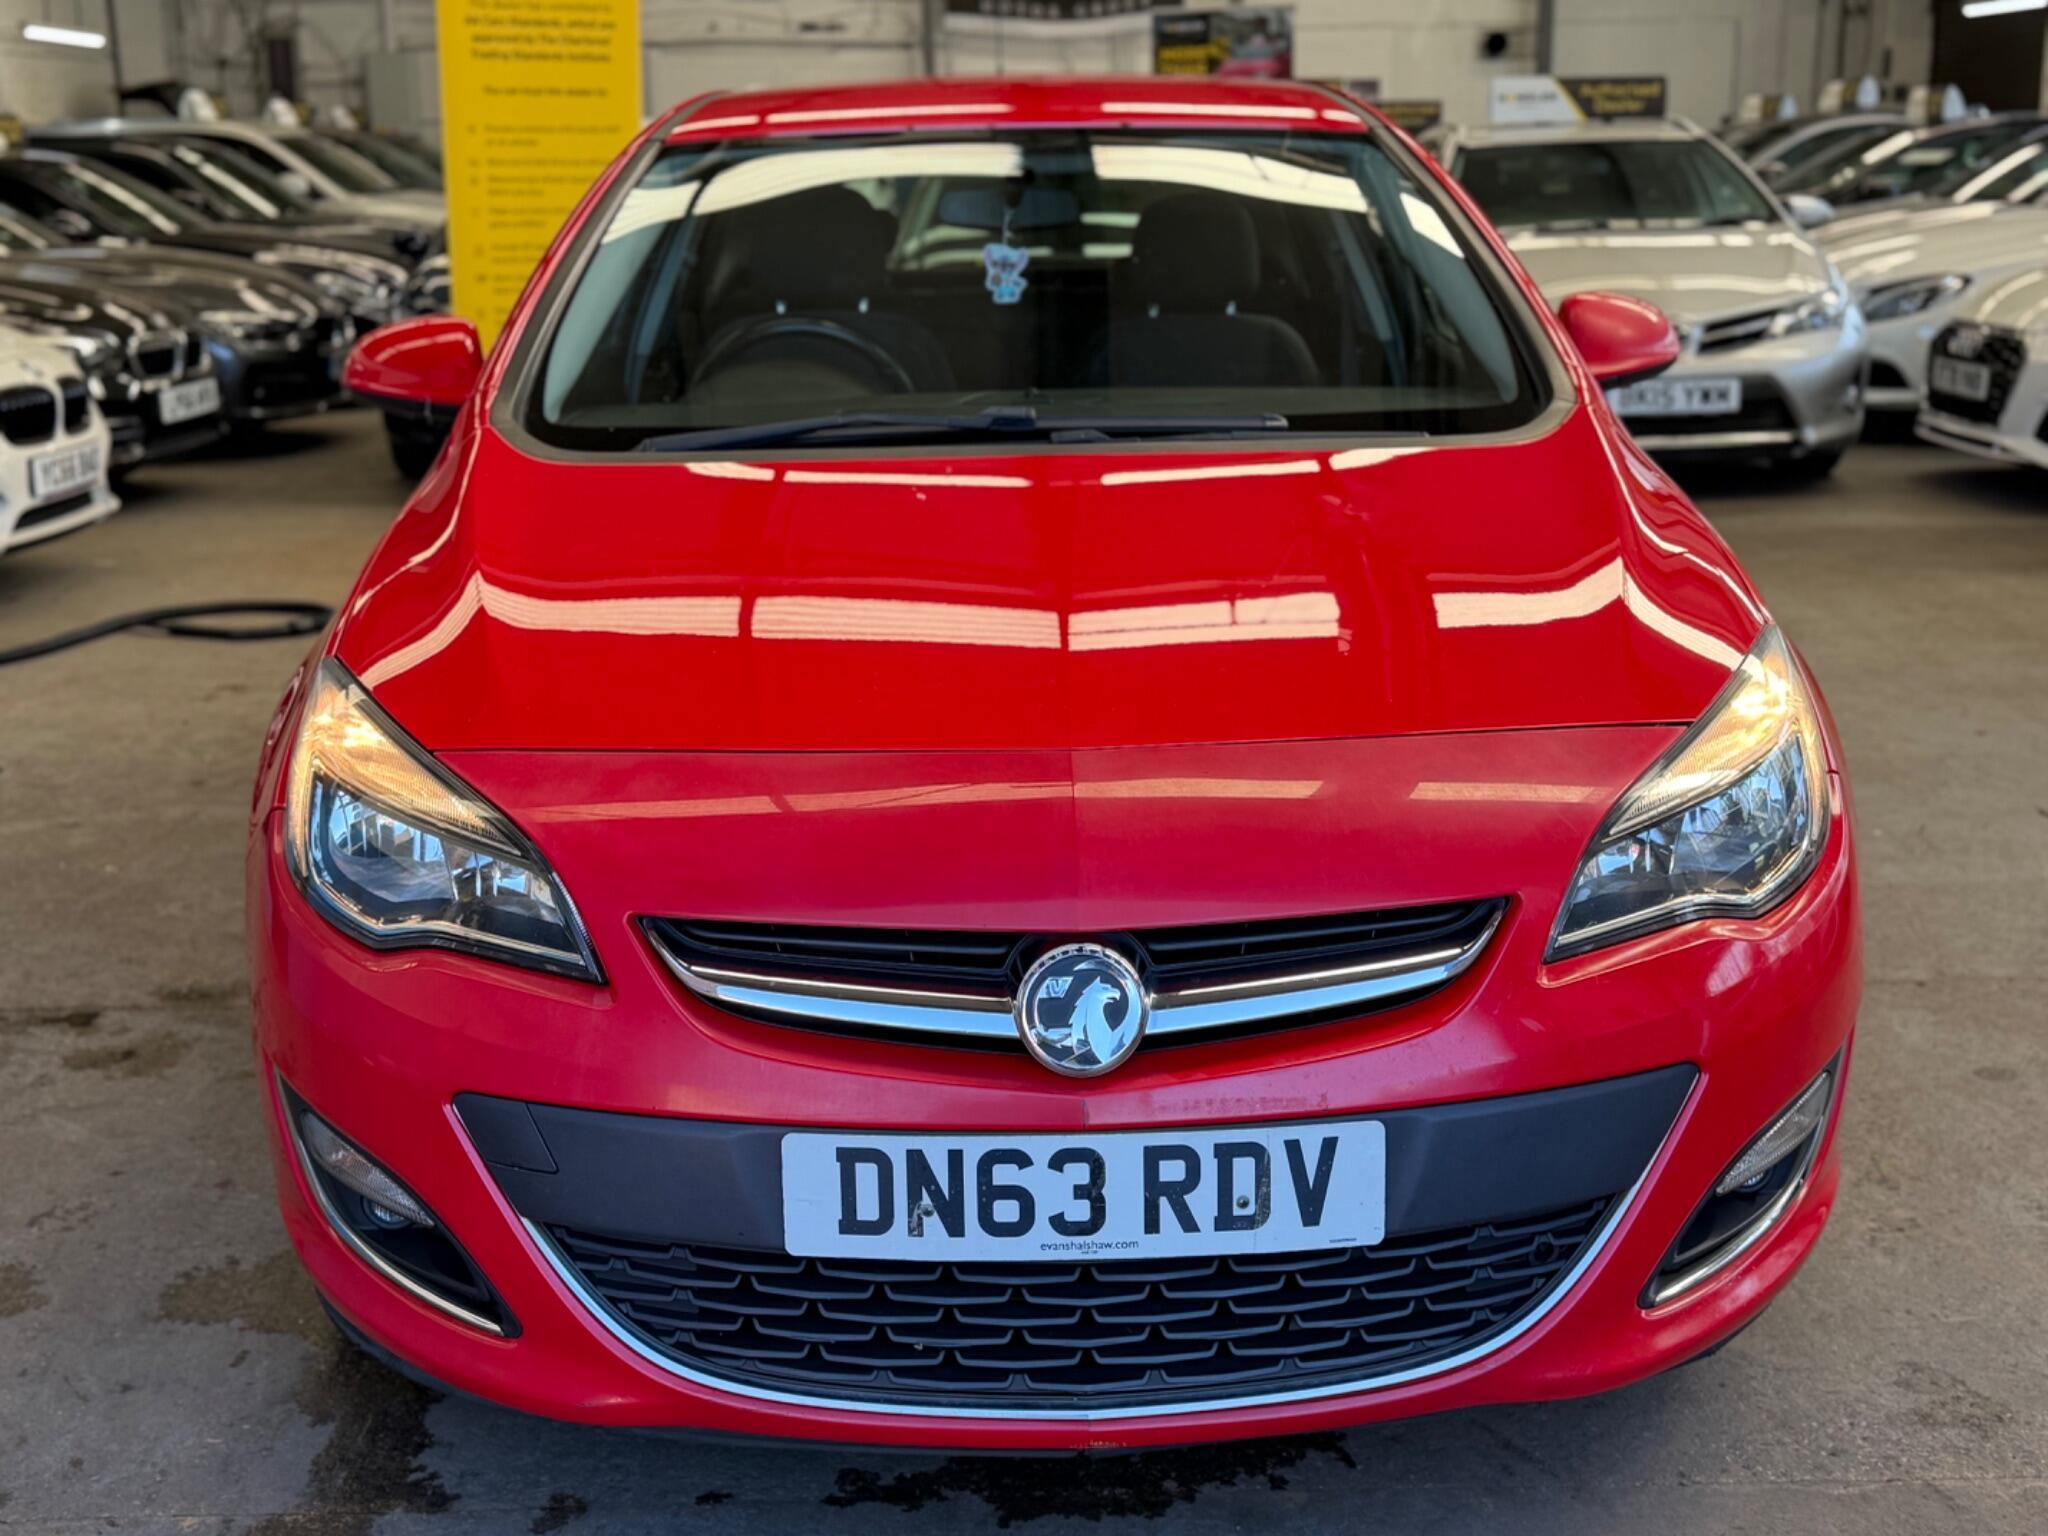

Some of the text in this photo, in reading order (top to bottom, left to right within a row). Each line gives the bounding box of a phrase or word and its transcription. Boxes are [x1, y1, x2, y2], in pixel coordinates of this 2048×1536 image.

[836, 1136, 1339, 1238] DN63 RDV
[1040, 1240, 1139, 1252] evanshalshaw.com
